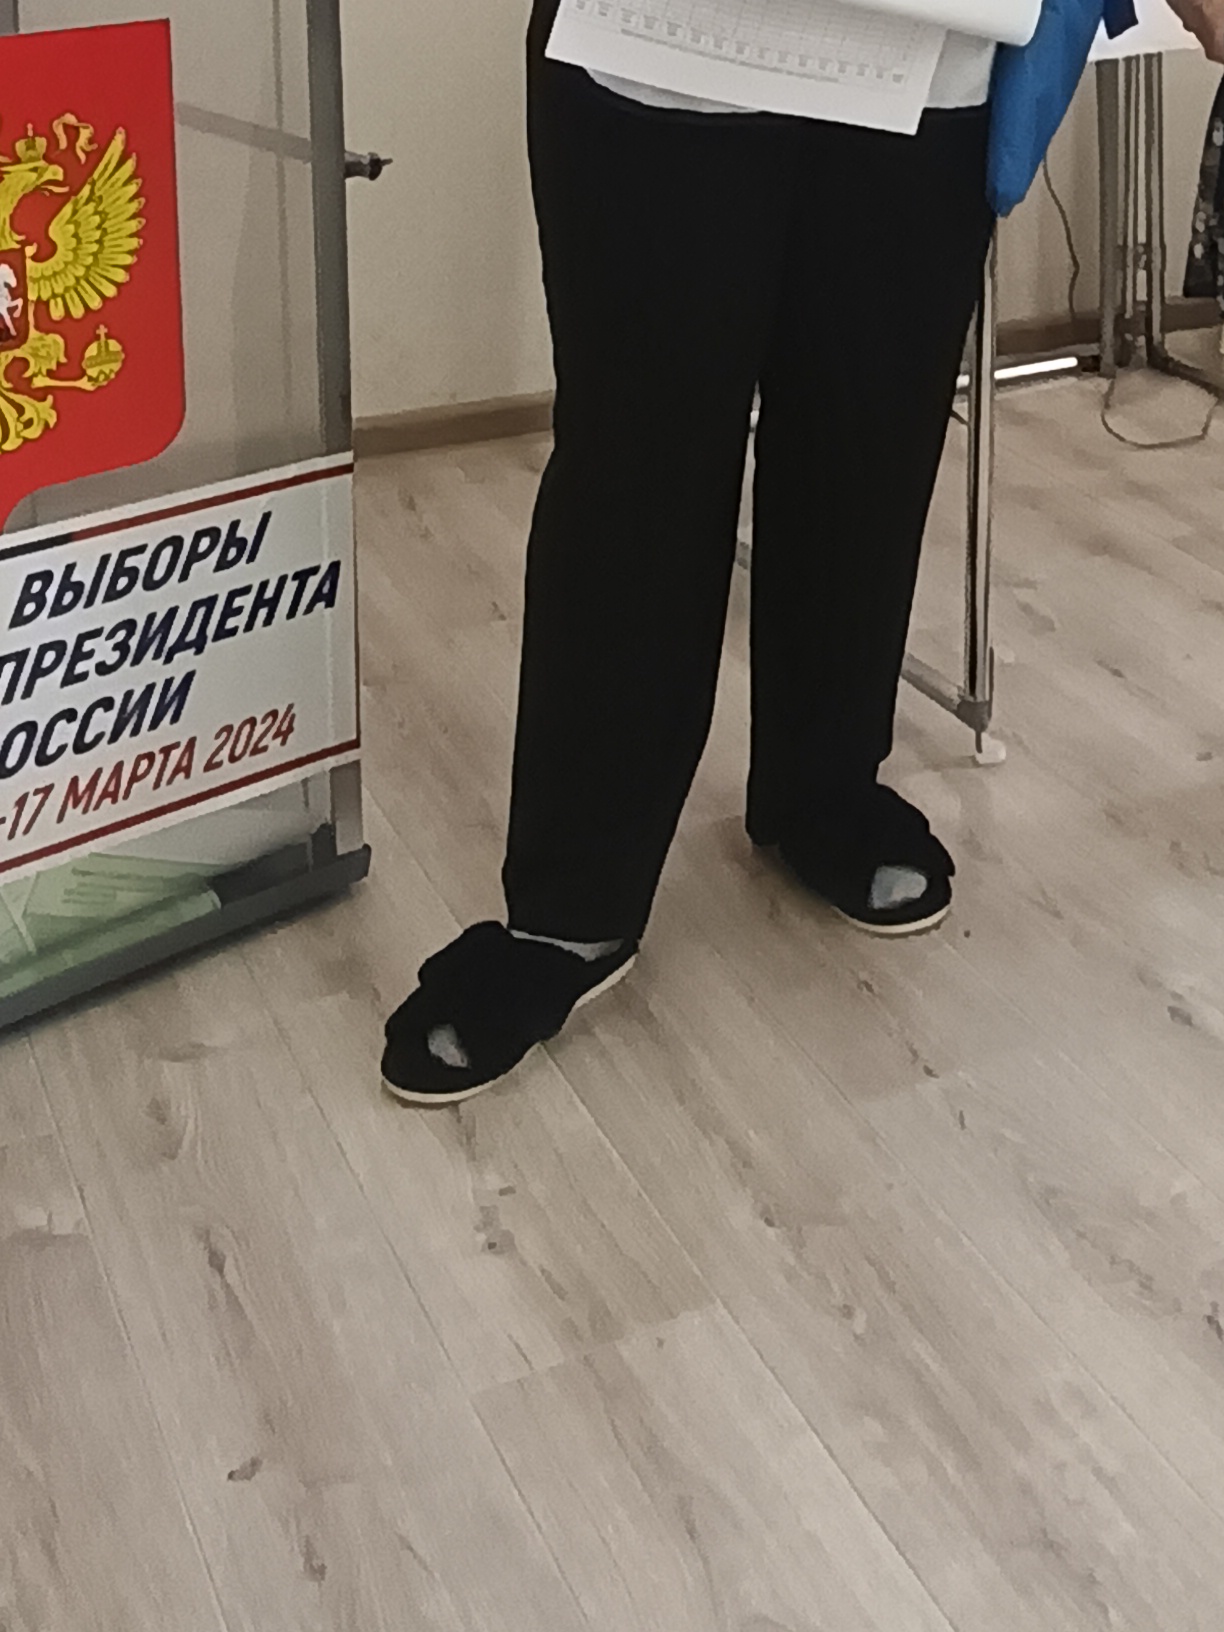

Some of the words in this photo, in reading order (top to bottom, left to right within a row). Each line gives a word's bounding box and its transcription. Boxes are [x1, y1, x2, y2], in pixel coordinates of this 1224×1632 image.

[8, 510, 272, 631] ВЫБОРЫ
[0, 560, 342, 706] ПРЕЗИДЕНТА
[56, 736, 198, 825] МАРТА
[203, 703, 297, 774] 2024
